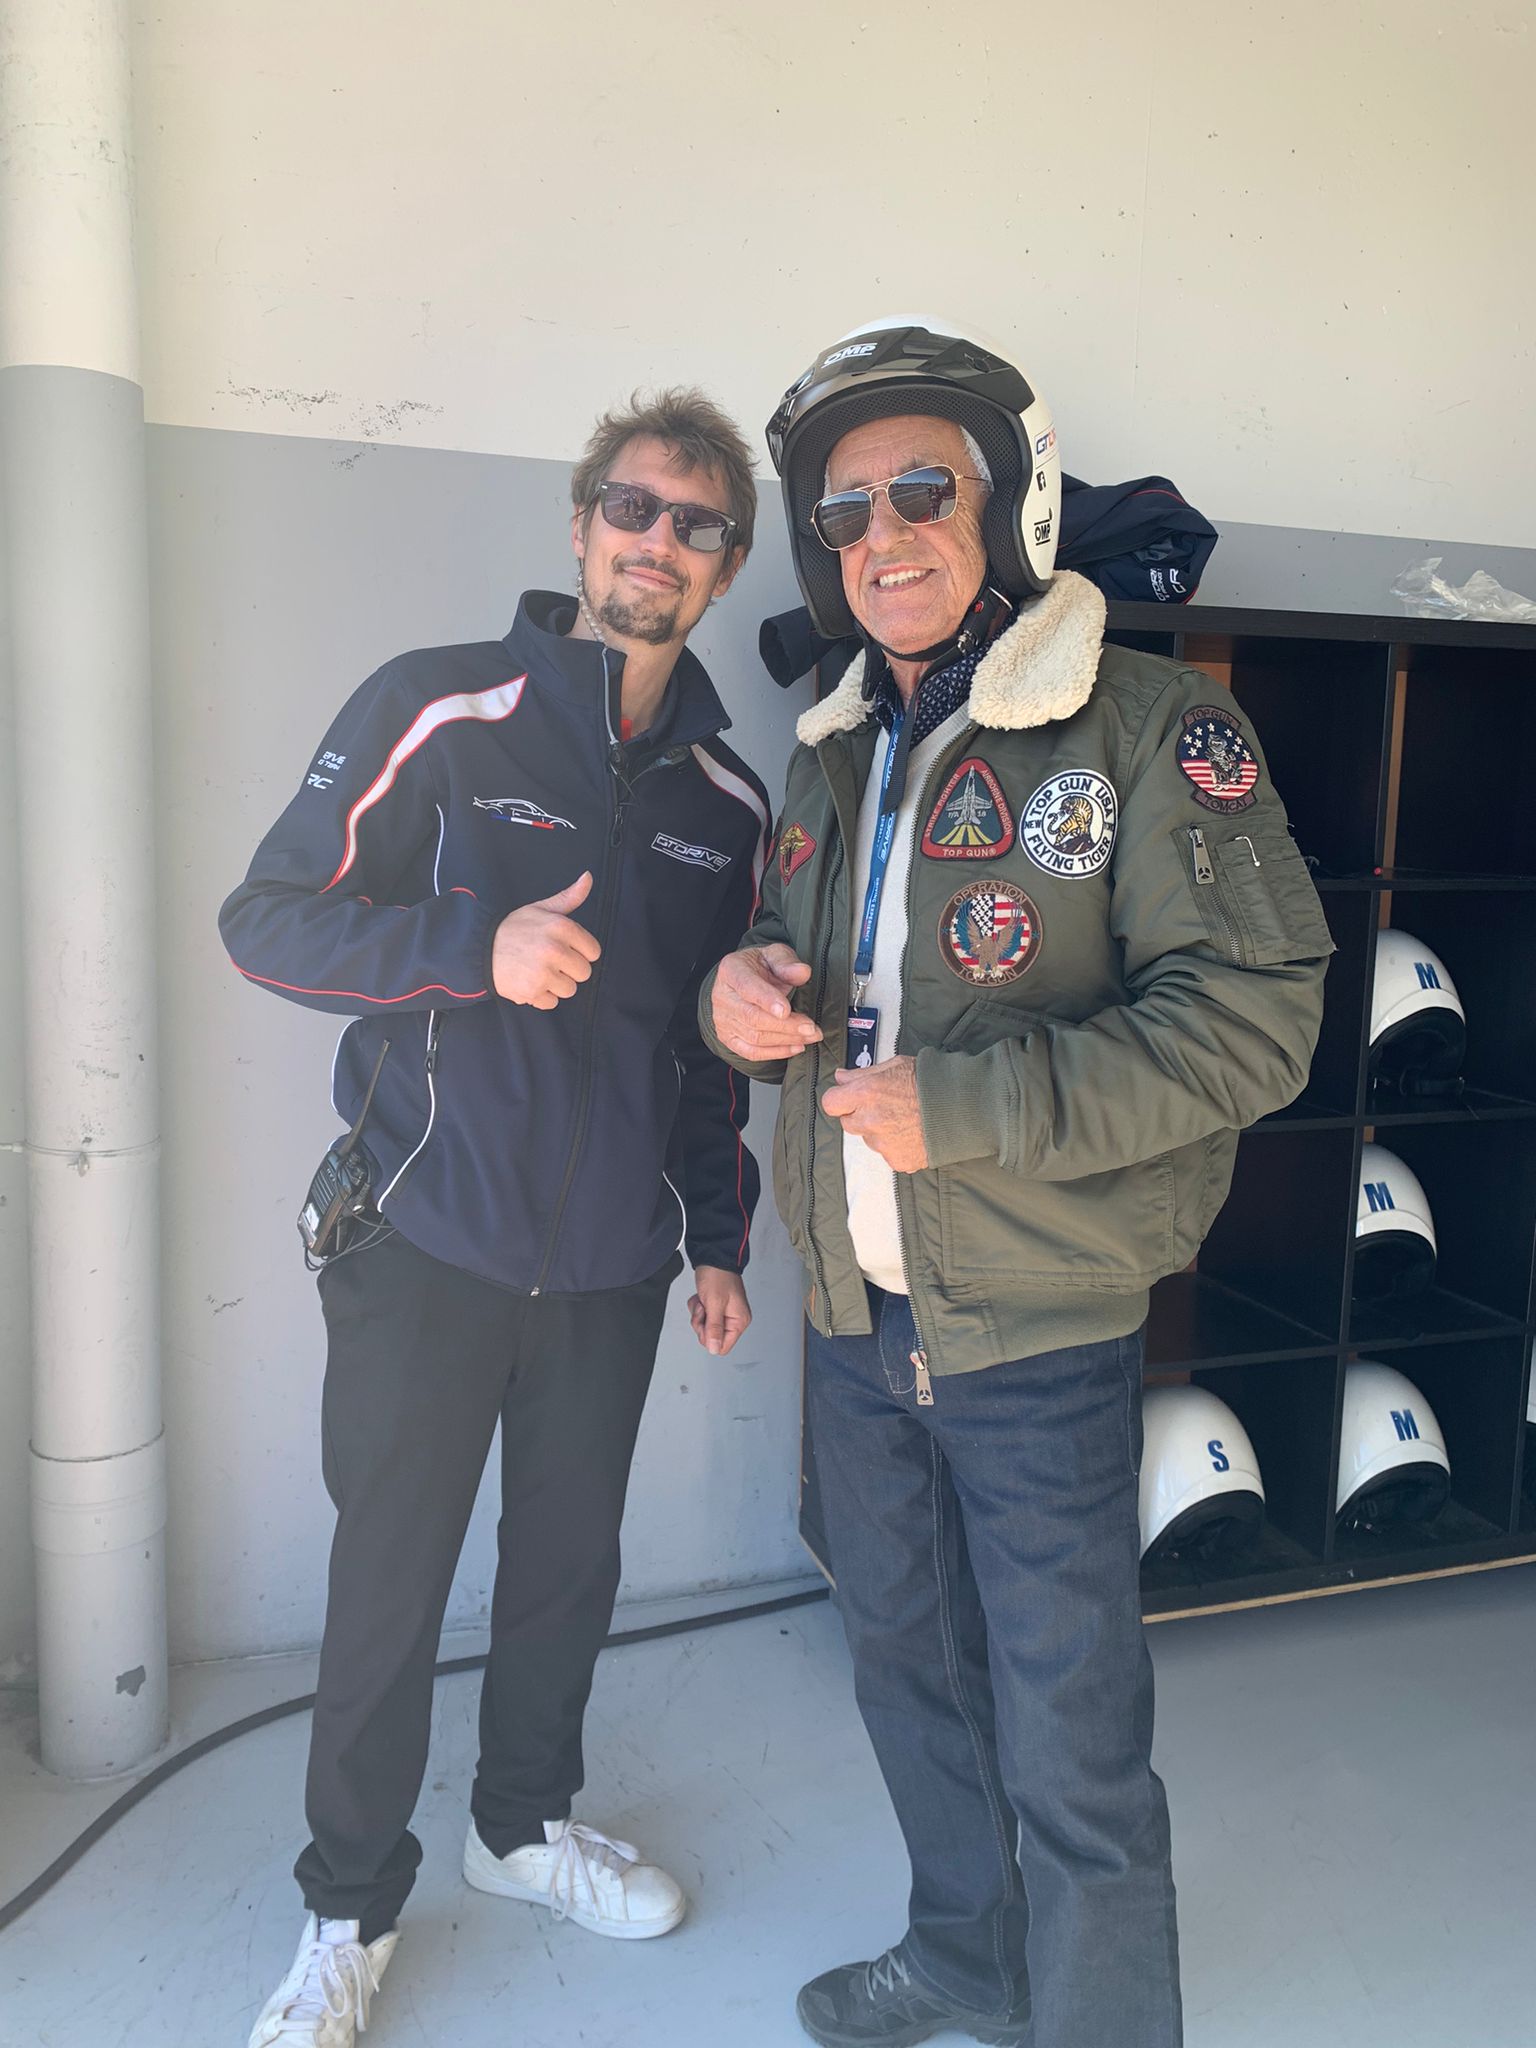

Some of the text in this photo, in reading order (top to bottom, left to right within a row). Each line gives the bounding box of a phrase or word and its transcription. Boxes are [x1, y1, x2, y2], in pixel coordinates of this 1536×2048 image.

[823, 344, 877, 365] OMP
[1035, 522, 1050, 541] OMP
[1029, 778, 1113, 819] TOP GUN USA
[997, 802, 1013, 835] DIVISION
[1024, 819, 1041, 829] NEW
[656, 836, 726, 867] GTDRIVE
[1028, 834, 1111, 870] FLYING TIGER
[953, 883, 1027, 906] OPERATION
[865, 904, 876, 941] EXPERIENCE
[1414, 962, 1441, 989] M
[1363, 1182, 1395, 1212] M
[1390, 1409, 1420, 1441] M
[1207, 1440, 1229, 1472] S
